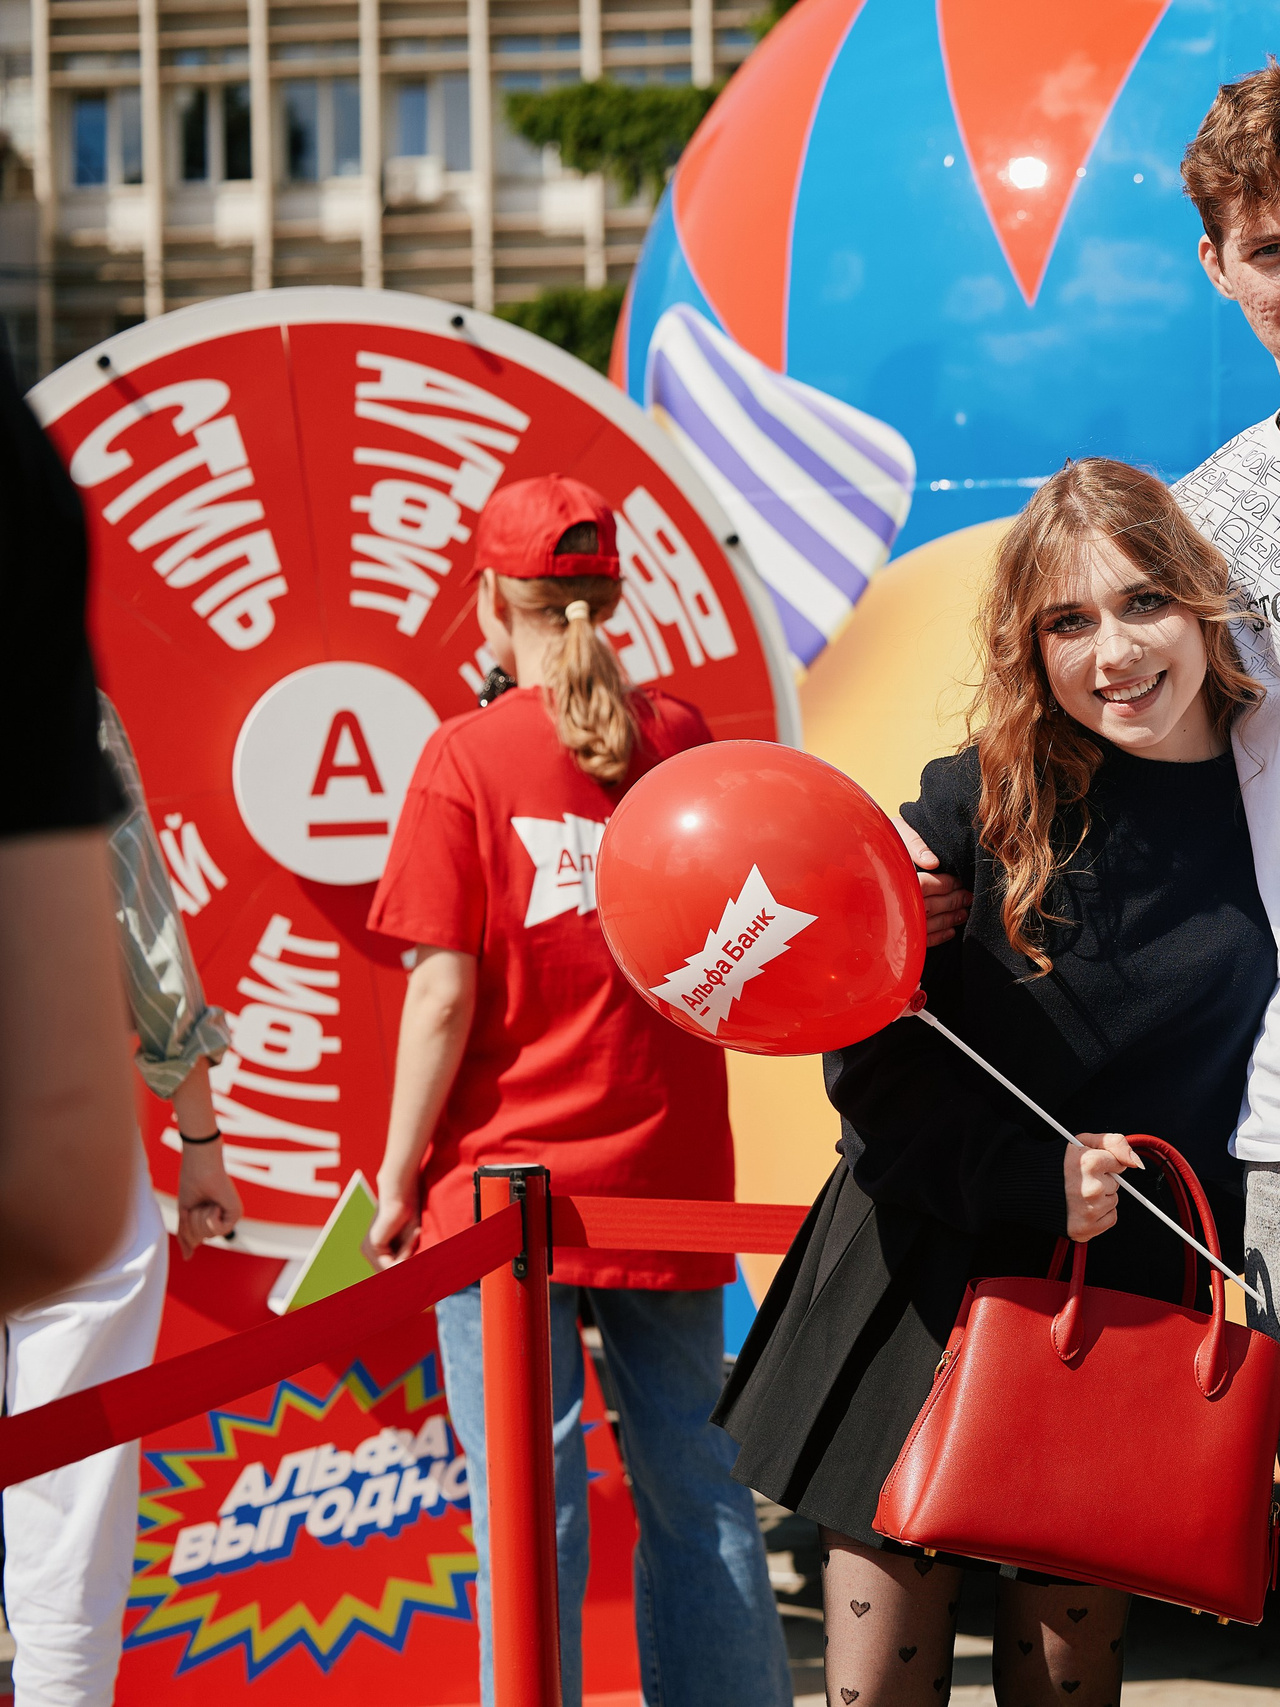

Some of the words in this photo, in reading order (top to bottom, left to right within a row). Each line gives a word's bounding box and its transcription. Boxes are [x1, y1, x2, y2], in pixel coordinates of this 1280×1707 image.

[70, 378, 288, 651] СТИЛЬ
[351, 350, 531, 636] АУТФИТ
[207, 914, 342, 1199] АУТФИТ
[681, 957, 733, 1014] Альфа
[721, 907, 776, 962] Банк
[217, 1414, 449, 1517] АЛЬФА
